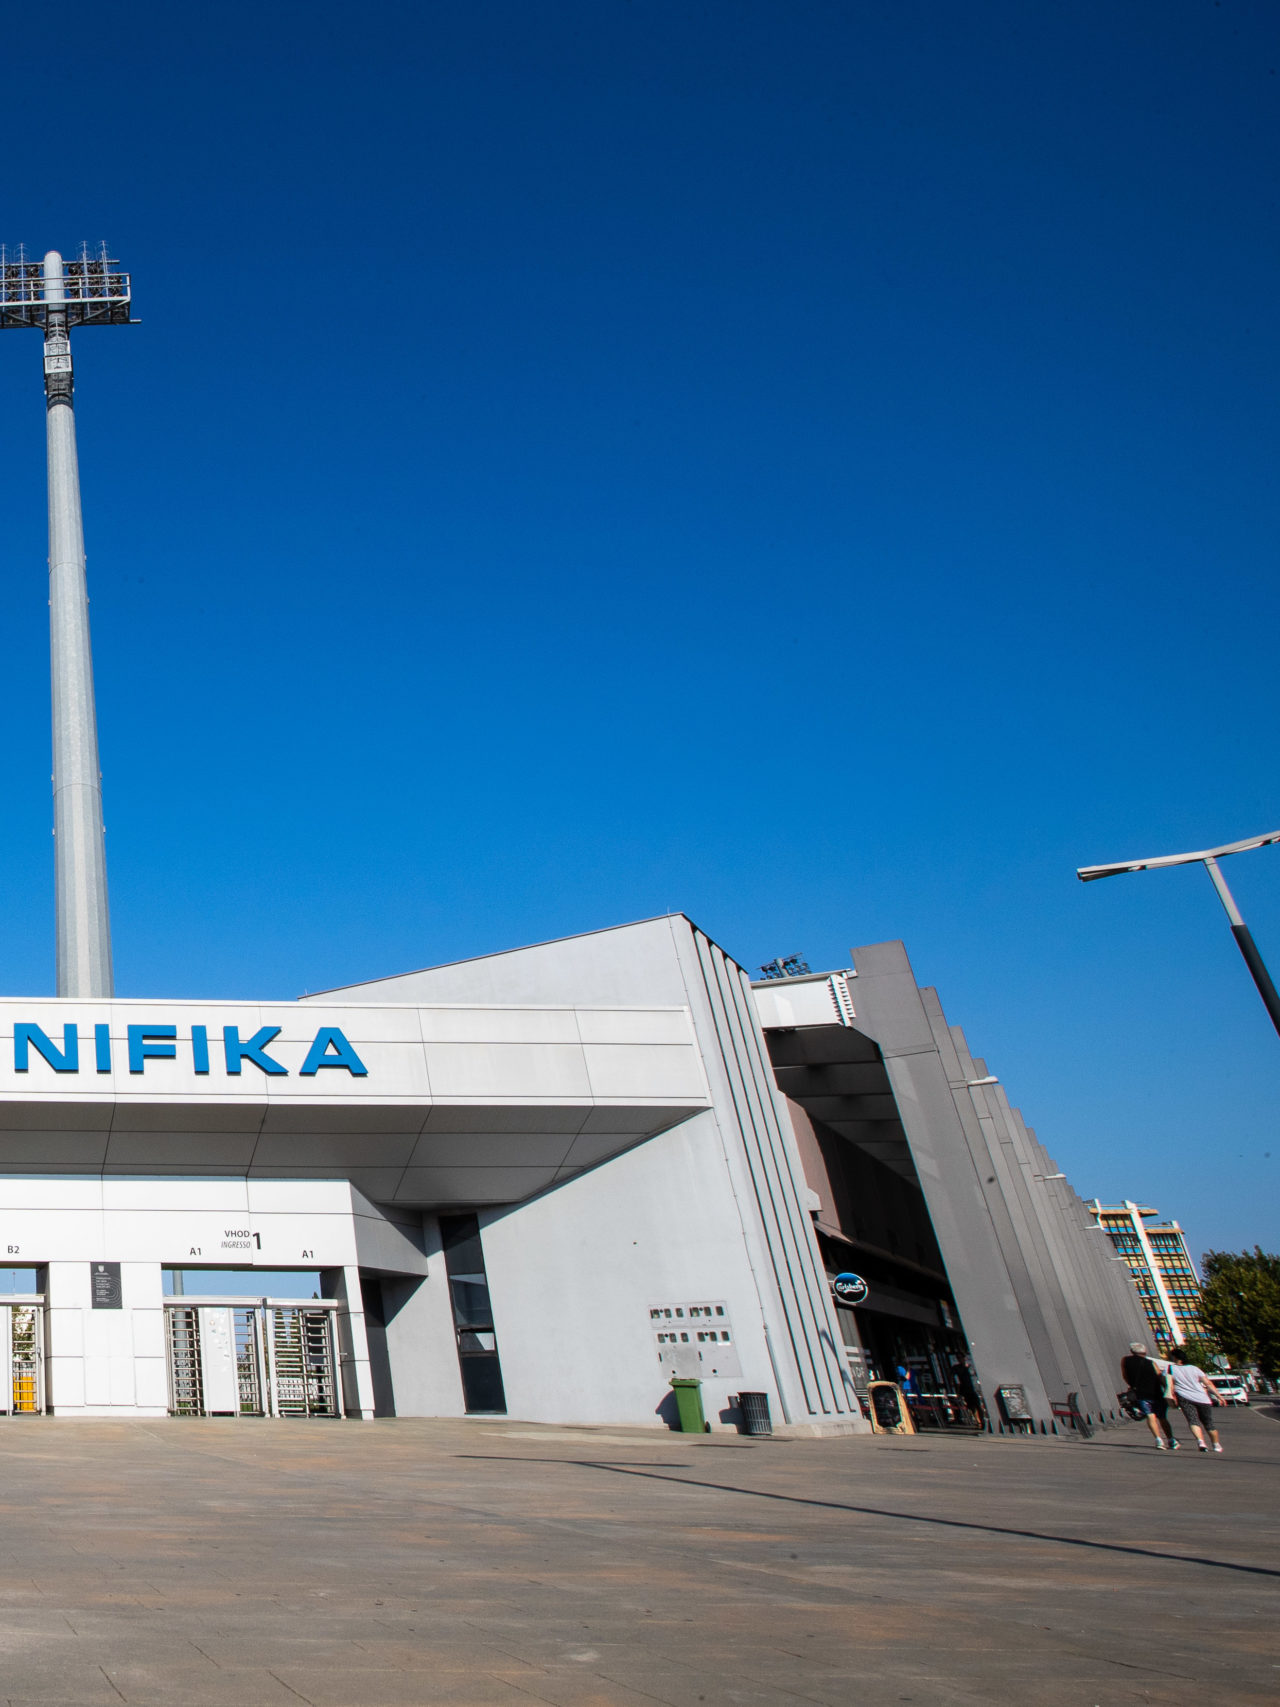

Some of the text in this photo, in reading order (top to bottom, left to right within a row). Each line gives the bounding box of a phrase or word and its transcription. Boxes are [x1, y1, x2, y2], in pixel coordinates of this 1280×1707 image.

[224, 1230, 250, 1238] VHOD
[220, 1240, 251, 1249] INGRESSO
[252, 1232, 262, 1250] 1
[7, 1245, 20, 1254] B2
[189, 1247, 202, 1256] A1
[302, 1250, 314, 1259] A1
